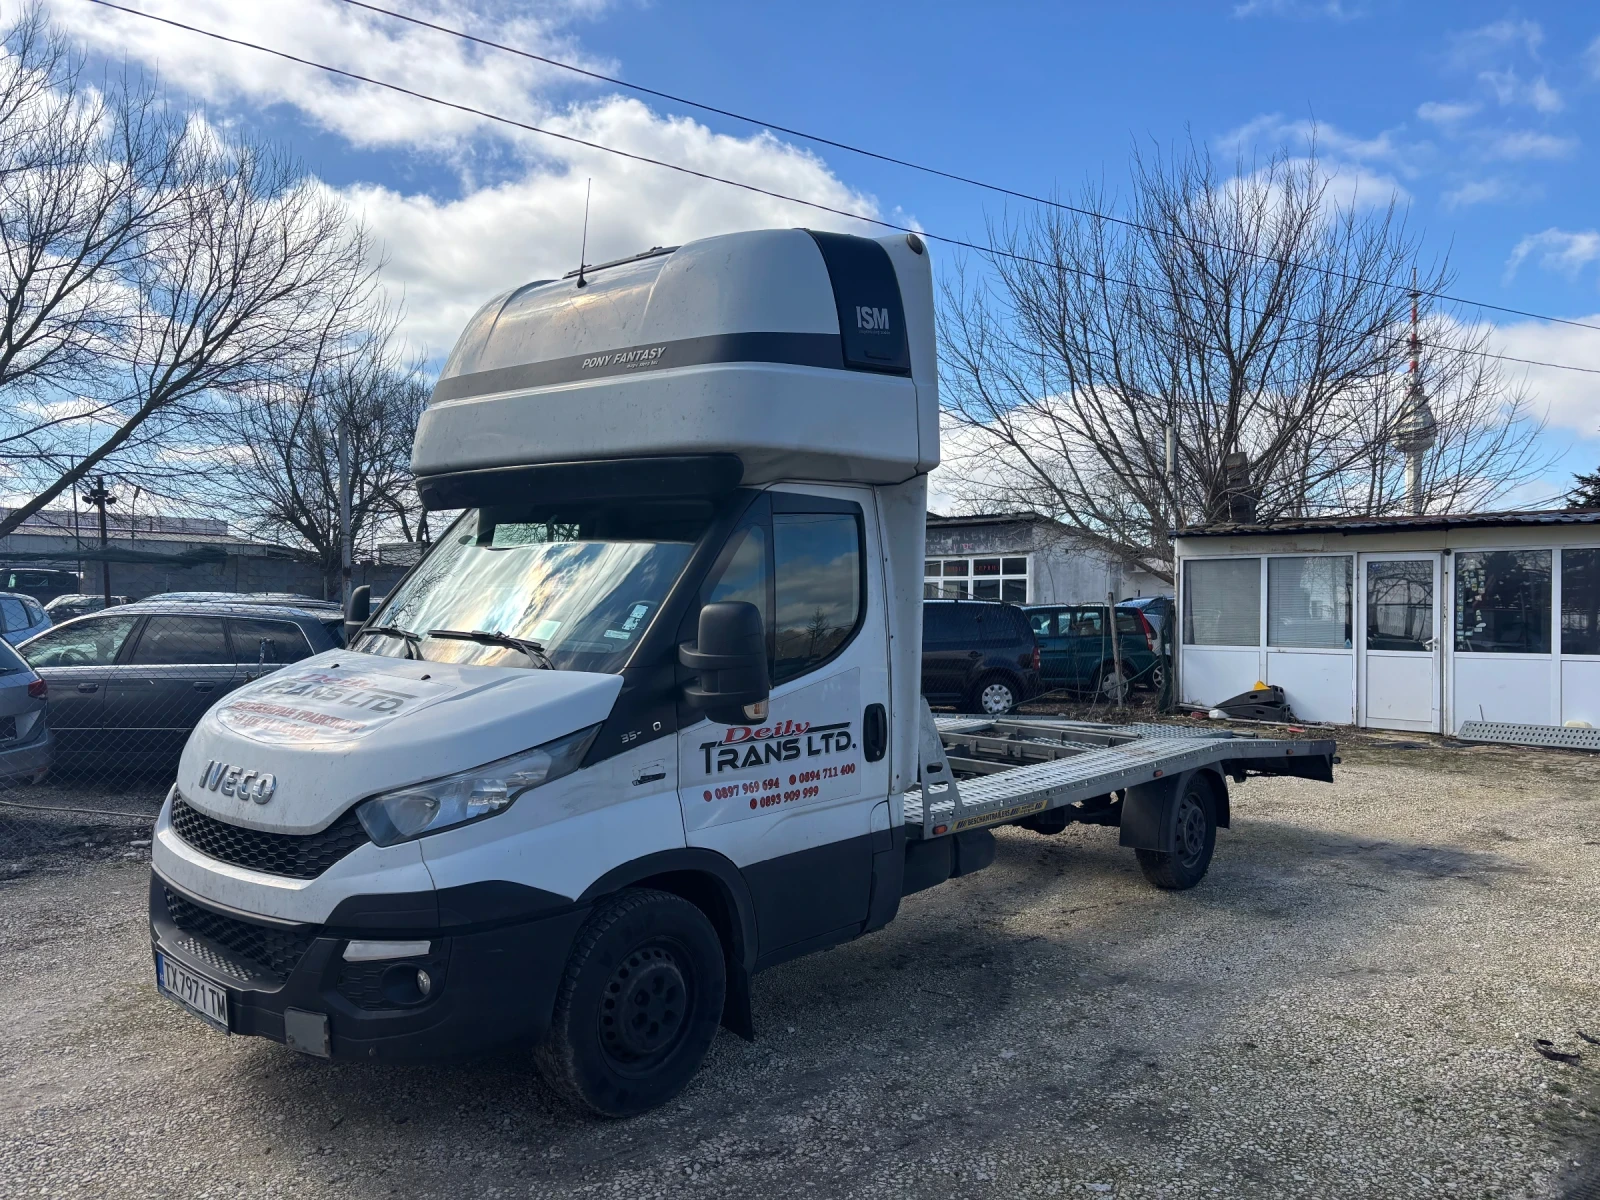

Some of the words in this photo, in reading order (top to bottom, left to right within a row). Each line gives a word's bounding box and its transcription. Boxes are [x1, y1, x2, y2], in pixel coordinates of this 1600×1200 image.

[856, 306, 889, 329] ISM
[582, 355, 612, 369] PONY
[613, 347, 666, 364] FANTASY
[722, 720, 810, 745] Deily
[699, 738, 800, 775] TRANS
[807, 731, 857, 756] LTD.
[198, 759, 277, 805] IVECO
[799, 769, 821, 784] 0894
[823, 766, 839, 779] 711
[840, 763, 856, 776] 400
[714, 784, 740, 800] 0897
[742, 781, 760, 795] 969
[762, 777, 780, 791] 694
[759, 794, 781, 808] 0893
[783, 789, 801, 803] 909
[802, 785, 819, 799] 999
